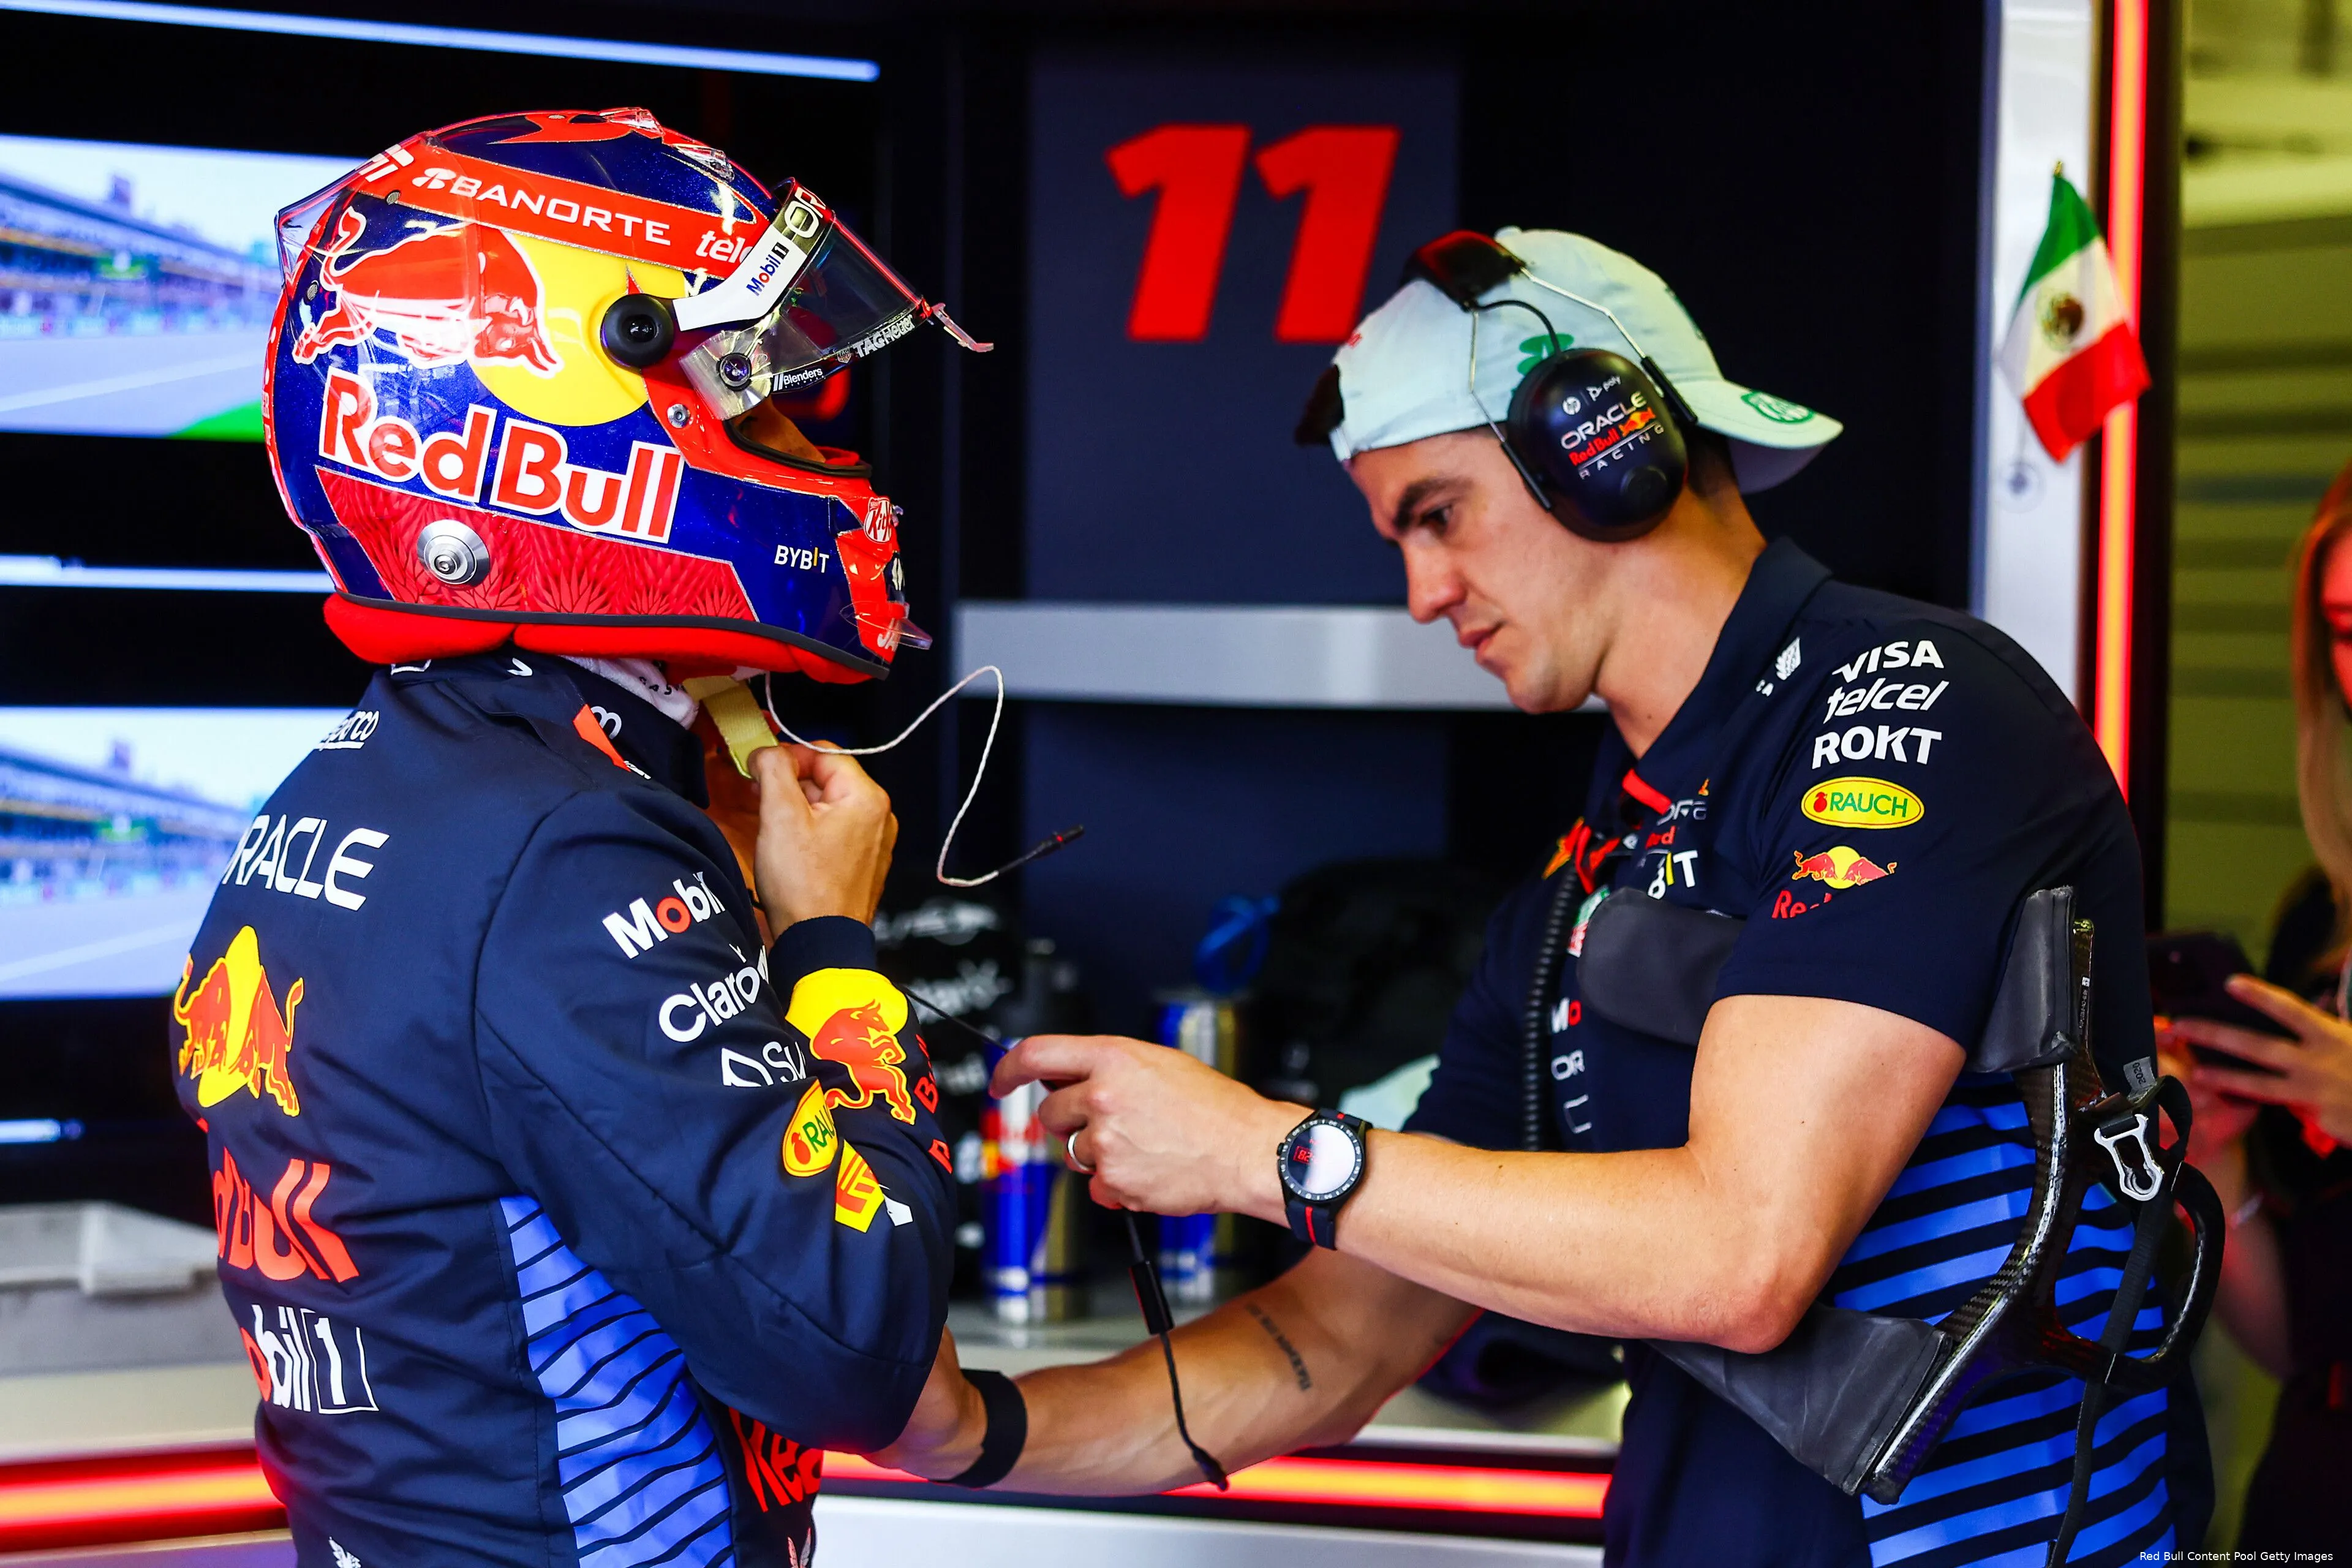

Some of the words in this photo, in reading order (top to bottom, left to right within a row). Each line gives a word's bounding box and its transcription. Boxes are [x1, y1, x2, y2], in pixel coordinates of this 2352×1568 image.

[450, 175, 672, 246] BANORTE
[1105, 123, 1403, 343] 11
[746, 254, 782, 296] Mobil
[771, 241, 790, 260] 1
[783, 367, 823, 386] Blenders
[1561, 391, 1647, 450] ORACLE
[1569, 442, 1597, 466] Red
[1594, 427, 1621, 451] Bull
[320, 367, 497, 503] Red
[491, 418, 685, 543] Bull
[1578, 422, 1665, 480] RACING
[774, 544, 830, 573] BYBIT
[1832, 640, 1945, 684] VISA
[1823, 677, 1950, 724] telcel
[1812, 725, 1942, 770] ROKT
[1829, 791, 1908, 818] RAUCH
[221, 813, 390, 911] RACLE
[658, 966, 760, 1042] Claro
